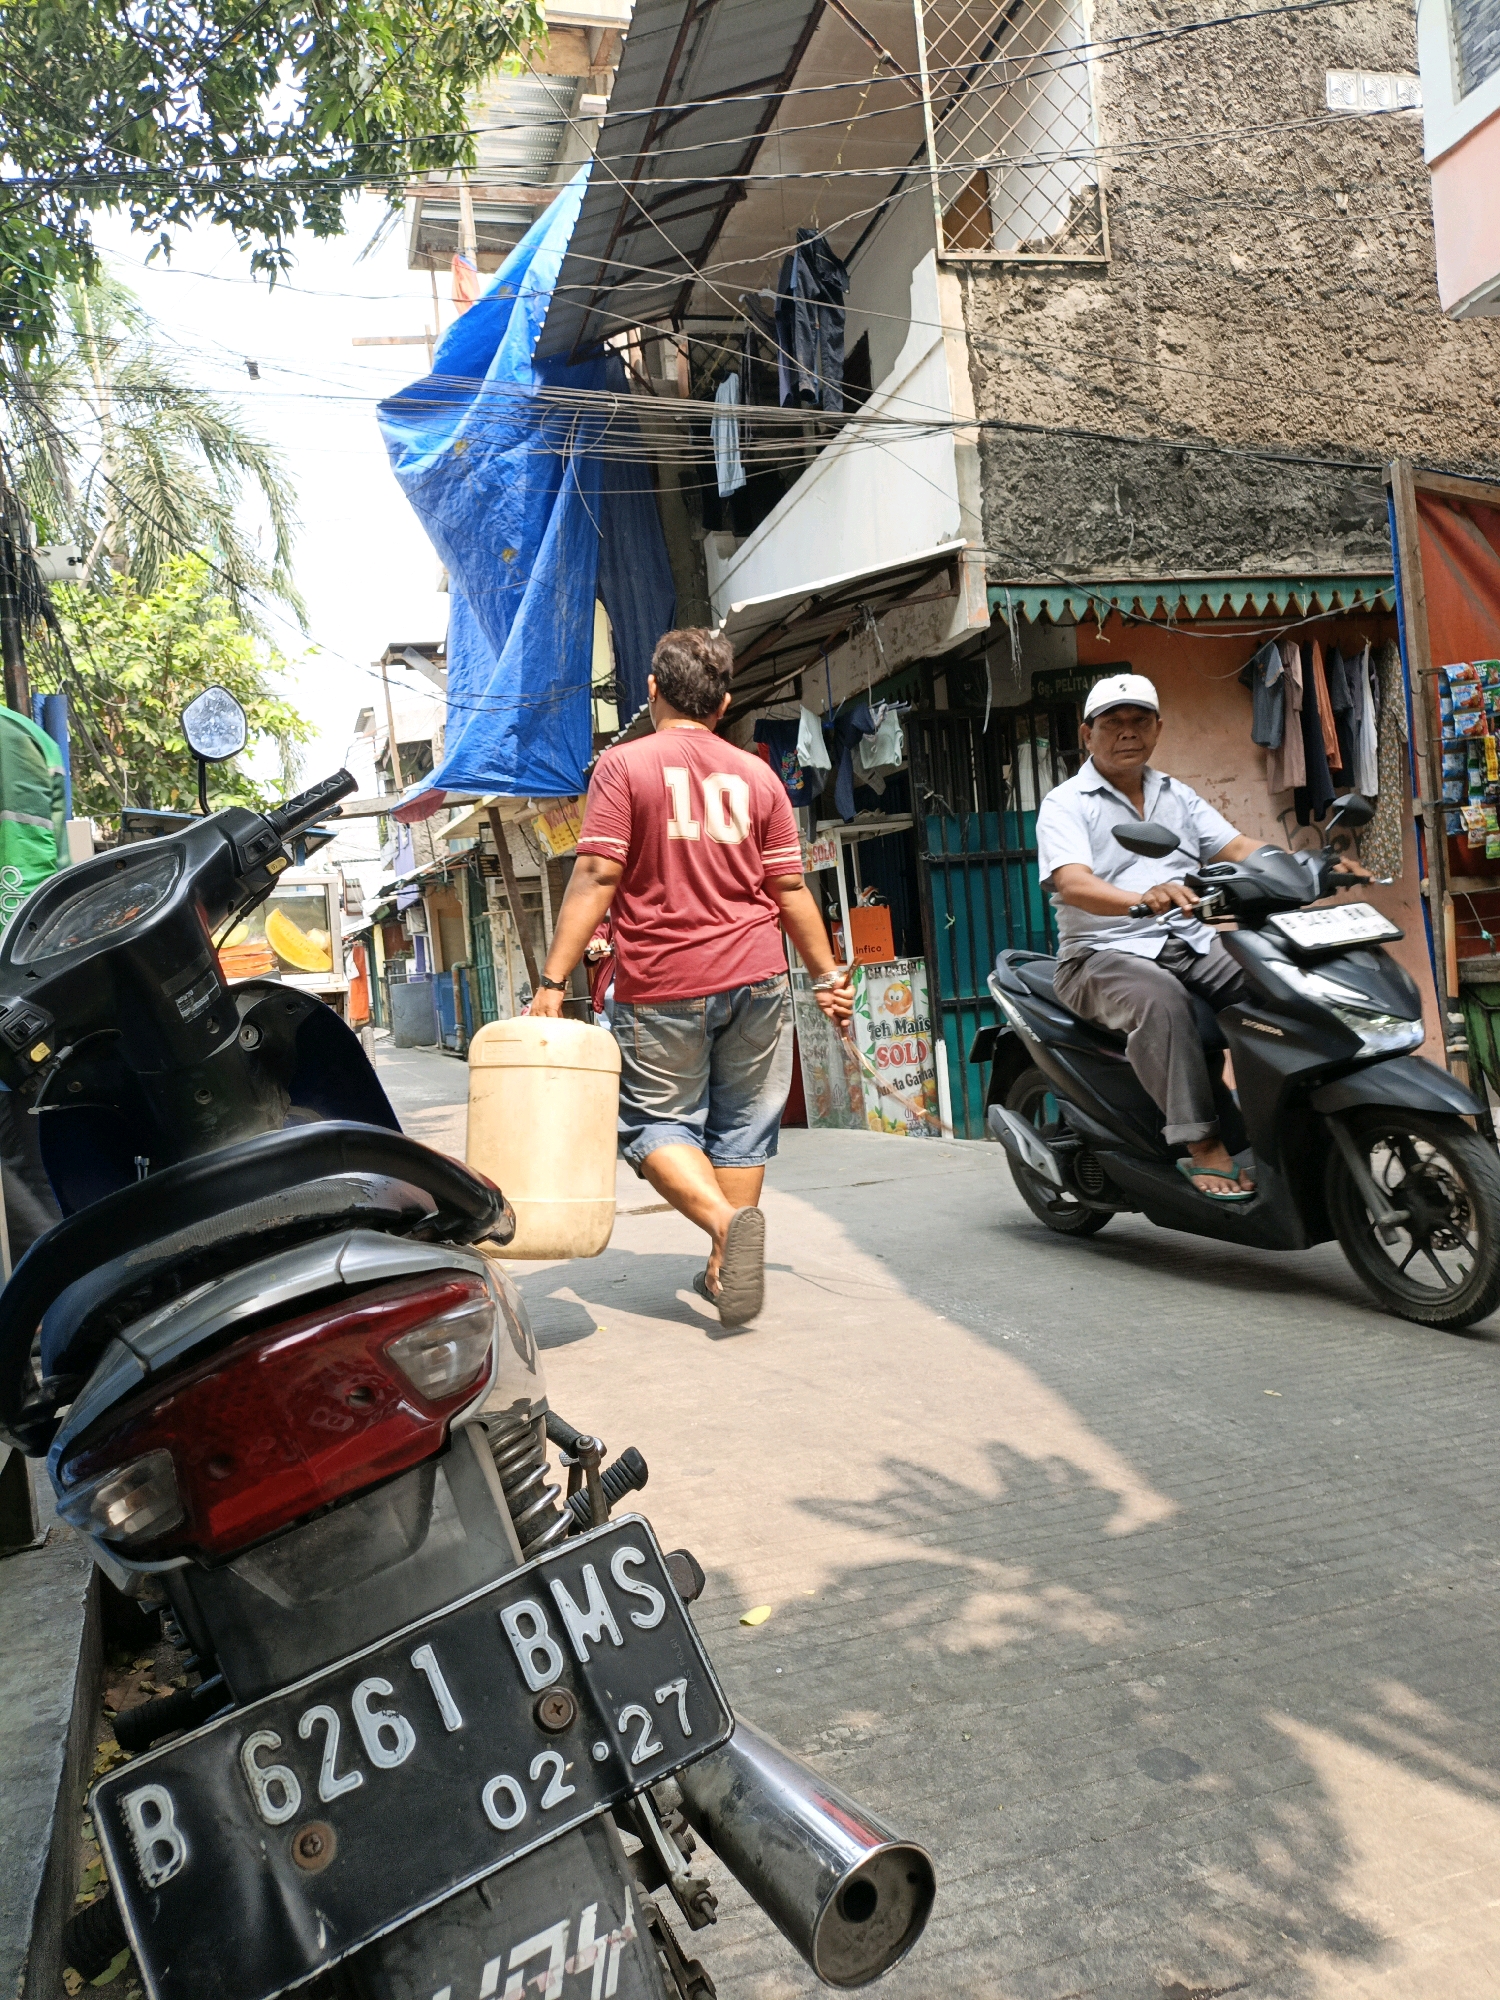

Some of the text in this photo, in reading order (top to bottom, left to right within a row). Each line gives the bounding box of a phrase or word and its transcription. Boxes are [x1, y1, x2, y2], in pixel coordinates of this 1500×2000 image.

[1055, 675, 1089, 693] PELITA
[663, 766, 750, 844] 10
[812, 841, 836, 863] SOLO
[867, 1020, 892, 1040] Teh
[876, 1040, 927, 1068] SOLO
[121, 1545, 666, 1889] B 6261 BMS
